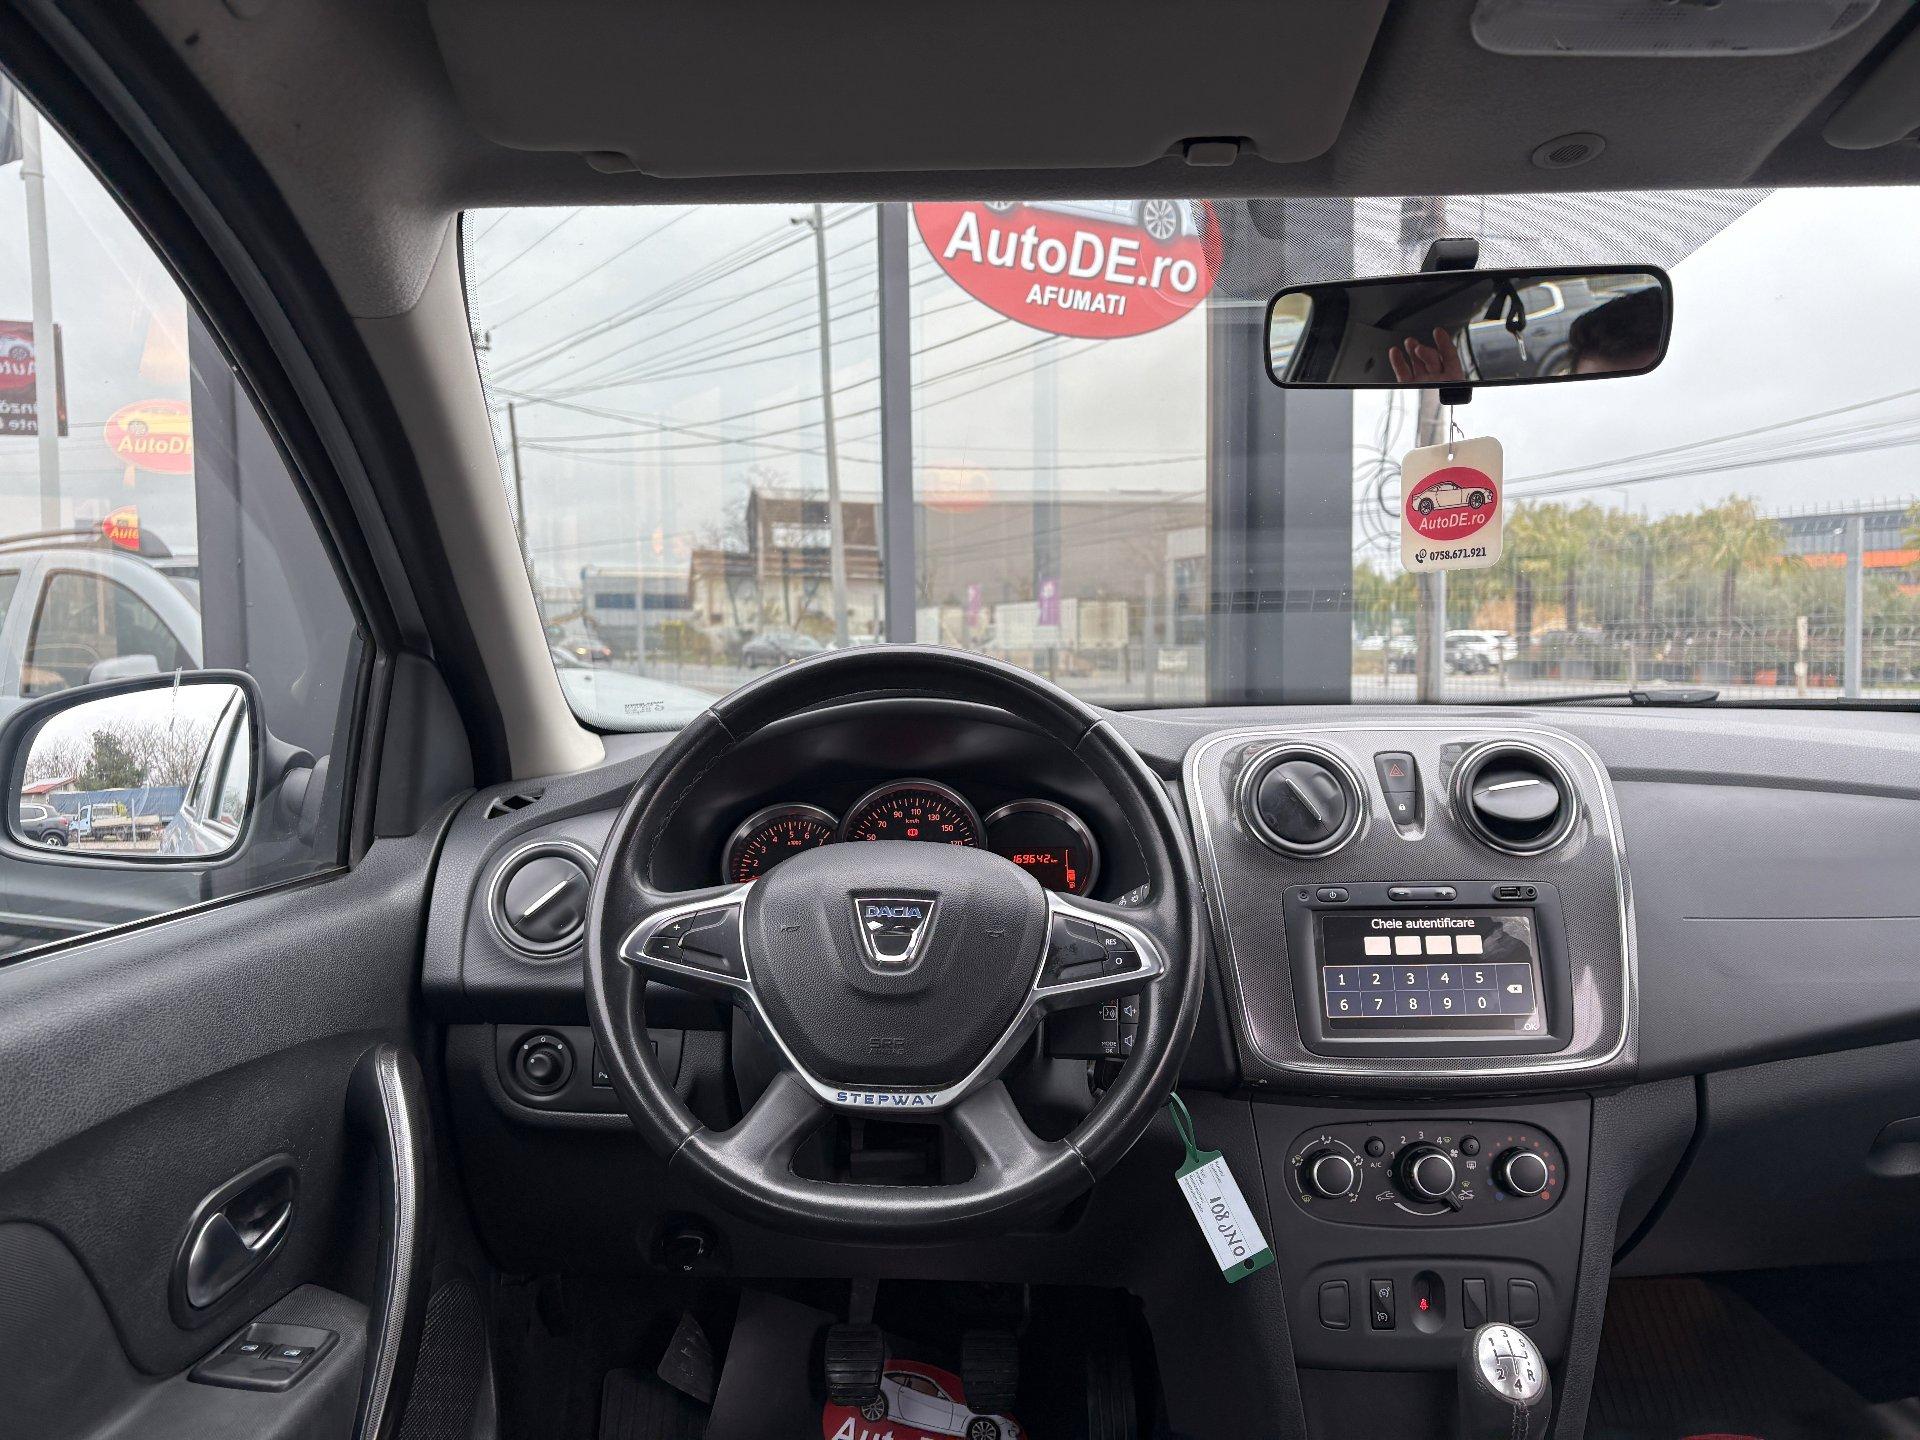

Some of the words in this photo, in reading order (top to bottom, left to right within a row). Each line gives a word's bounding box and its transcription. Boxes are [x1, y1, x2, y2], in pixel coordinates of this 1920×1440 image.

[943, 211, 1198, 294] AutoDE.ro
[1026, 284, 1127, 316] AFUMATI
[1419, 512, 1486, 531] AutoDE.ro
[1429, 546, 1487, 561] 0758.671.921
[878, 820, 887, 828] 70
[893, 810, 903, 818] 90
[911, 808, 921, 816] 110
[928, 813, 940, 821] 130
[941, 824, 954, 832] 150
[753, 859, 759, 867] 2
[761, 845, 767, 853] 3
[804, 831, 810, 839] 6
[1013, 854, 1051, 864] 169642
[865, 905, 922, 918] DACIA
[1371, 918, 1403, 930] Cheie
[1405, 917, 1476, 930] autentificare
[1338, 973, 1346, 986] 1
[1372, 973, 1381, 985] 2
[1406, 972, 1415, 985] 3
[1440, 972, 1450, 984] 4
[1475, 971, 1484, 984] 5
[1340, 999, 1349, 1011] 6
[1374, 998, 1383, 1010] 7
[1409, 997, 1418, 1010] 8
[1443, 996, 1452, 1009] 9
[1478, 996, 1487, 1009] 0
[1523, 1022, 1538, 1031] OK
[836, 1091, 938, 1106] STEPWAY
[1390, 1151, 1396, 1159] 1
[1400, 1135, 1407, 1144] 2
[1418, 1131, 1424, 1140] 3
[1436, 1136, 1443, 1145] 4
[1370, 1161, 1382, 1169] A/C
[1500, 1329, 1508, 1338] 3
[1496, 1368, 1506, 1380] 2
[1514, 1378, 1522, 1392] 4
[1526, 1368, 1536, 1382] R
